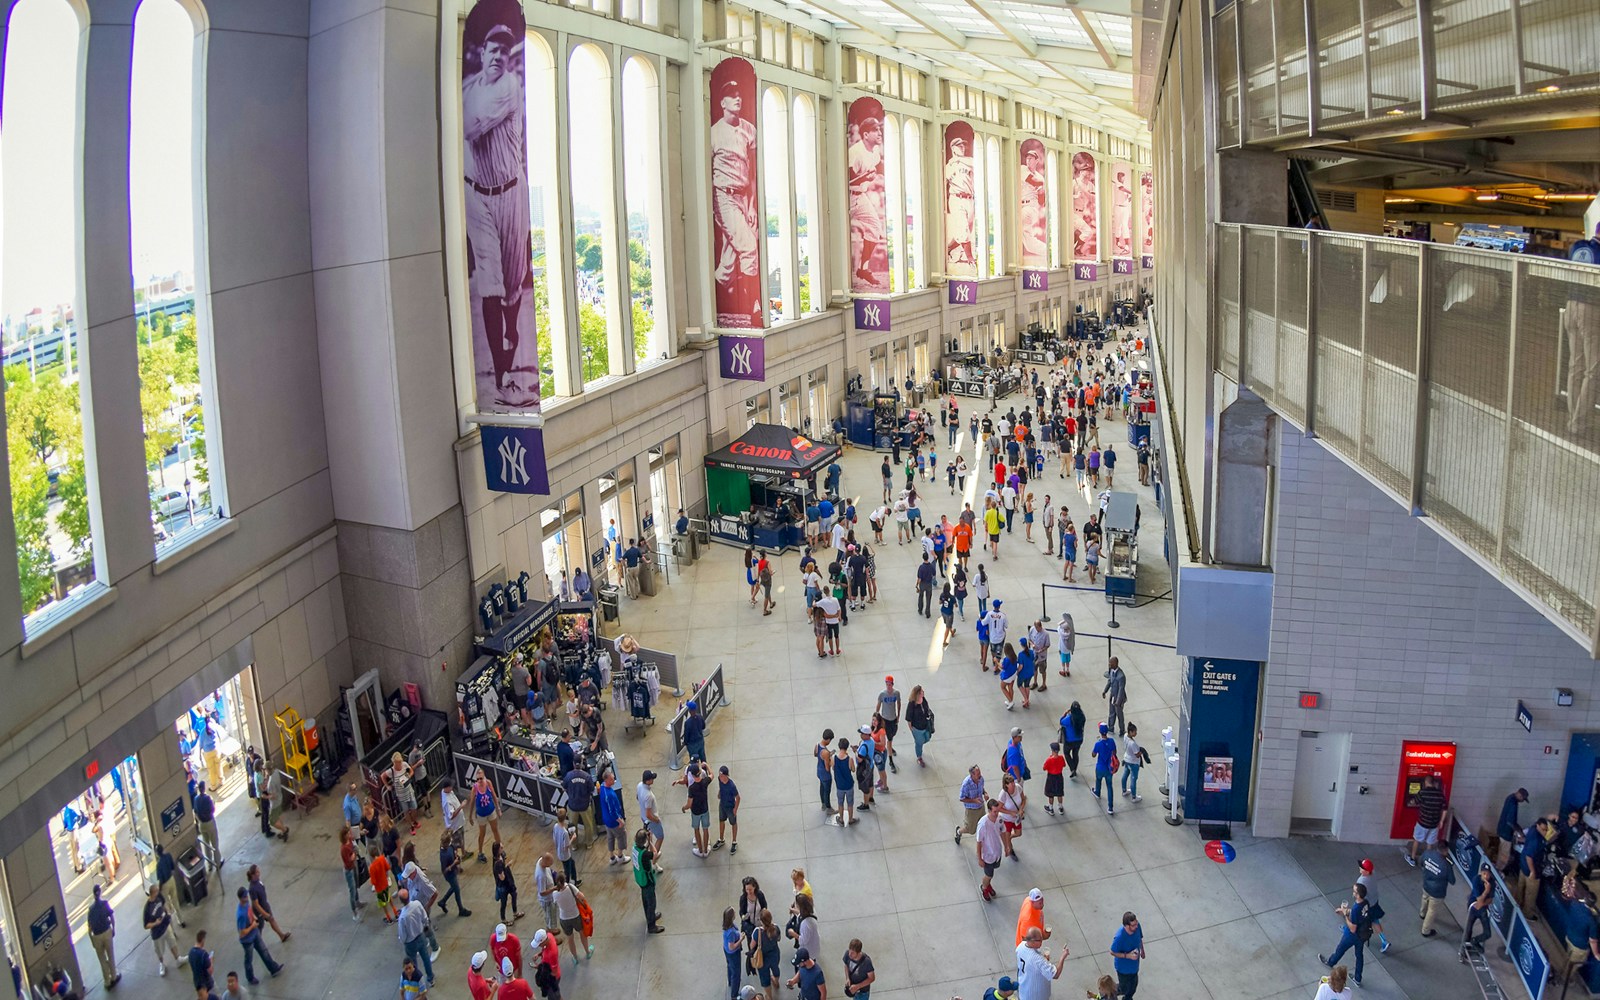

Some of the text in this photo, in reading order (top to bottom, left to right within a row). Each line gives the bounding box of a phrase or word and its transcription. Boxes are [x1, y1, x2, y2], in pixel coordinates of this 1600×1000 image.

[1029, 272, 1042, 288] NY
[1080, 265, 1091, 279] NY
[955, 283, 970, 302] NY
[863, 303, 881, 327] NY
[730, 342, 753, 375] NY
[497, 435, 531, 486] NY
[729, 441, 793, 461] Canon
[736, 464, 755, 472] STADIUM
[755, 467, 786, 476] PHOTOGRAPHY
[710, 519, 720, 534] NY
[738, 525, 748, 541] NY
[512, 606, 554, 644] OFFICIAL MERCHANDISE
[1202, 671, 1237, 681] EXIT GATE 6
[1301, 694, 1318, 708] EXIT
[1518, 711, 1531, 731] ATM
[506, 790, 535, 807] Majestic
[1019, 957, 1026, 975] 7
